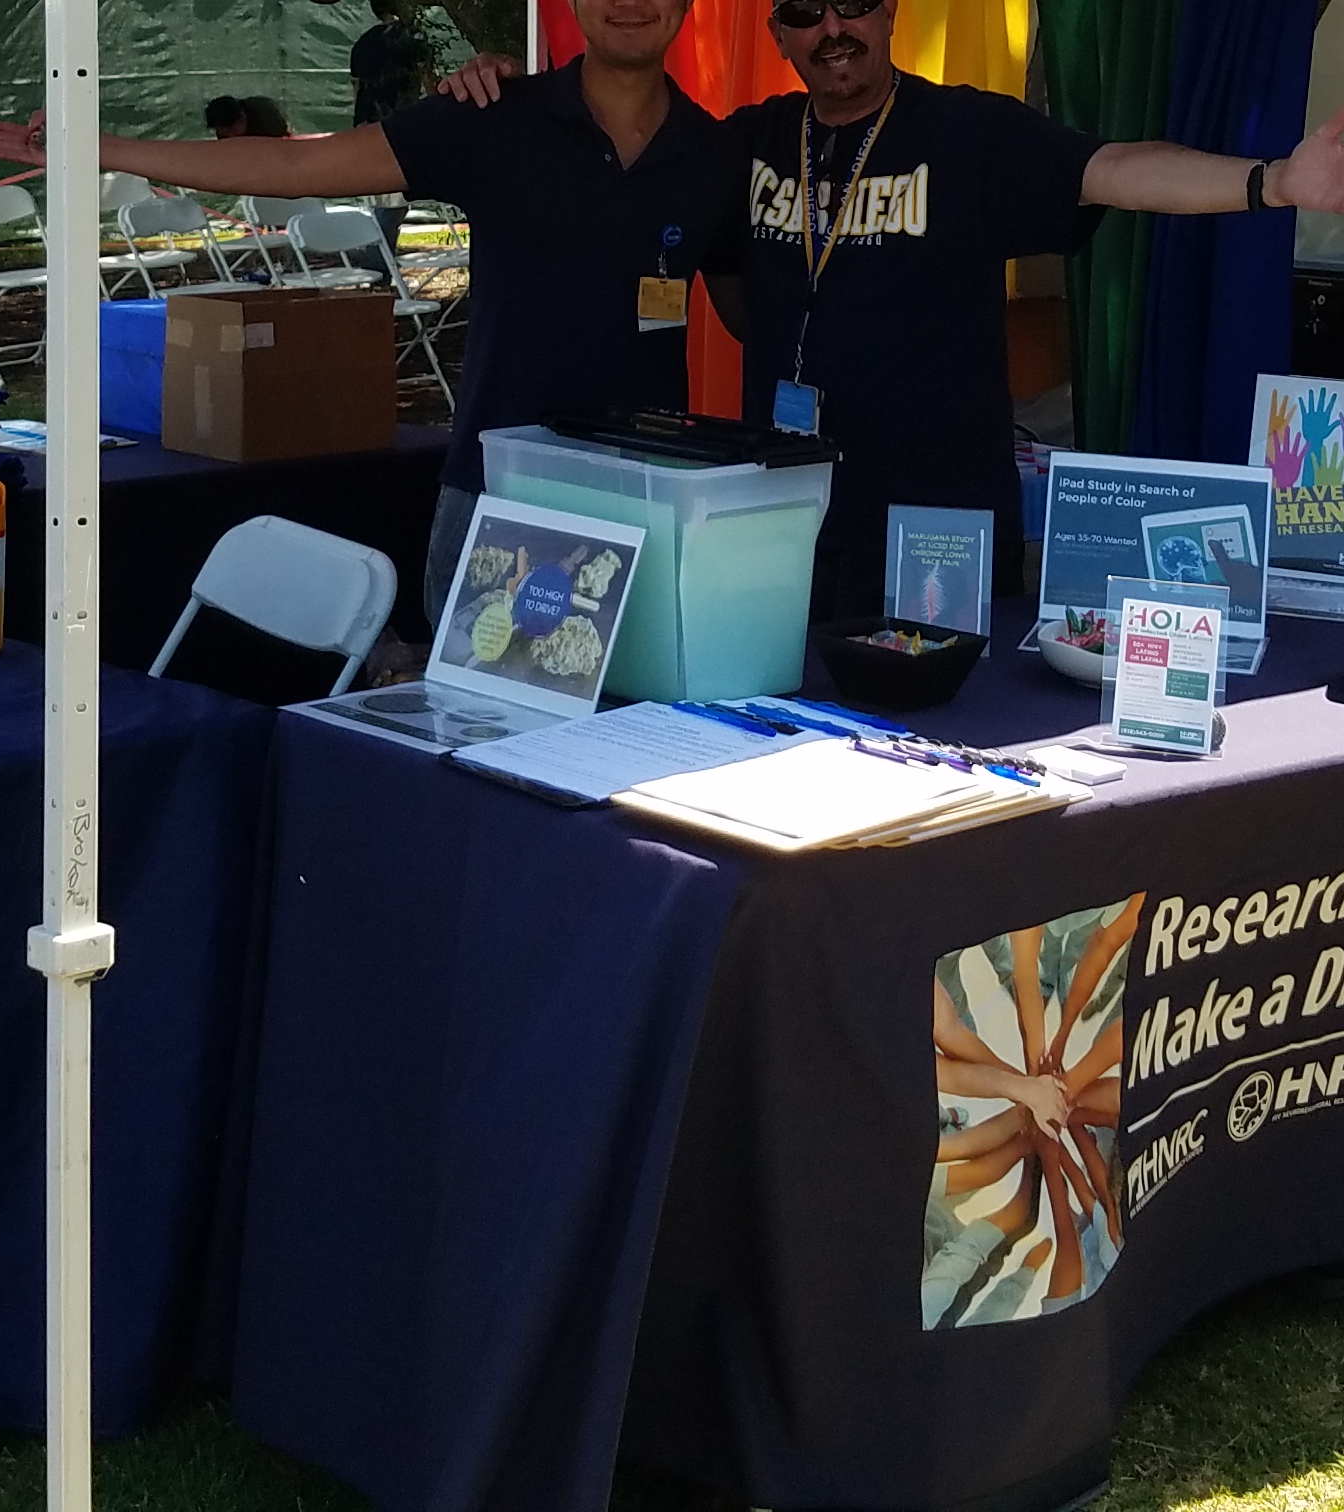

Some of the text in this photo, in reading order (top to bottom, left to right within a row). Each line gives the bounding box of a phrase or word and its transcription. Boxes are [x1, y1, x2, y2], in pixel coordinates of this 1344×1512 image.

[1059, 477, 1196, 498] iPad Study in Search of
[1275, 484, 1344, 503] HAVE
[1058, 492, 1147, 508] People of Color
[1054, 532, 1138, 547] Ages 35-70 Wanted
[1277, 525, 1293, 536] IN
[529, 585, 564, 602] TOO HIGH
[525, 598, 561, 616] TO DRIVE?
[1128, 605, 1213, 636] HOLA
[1127, 978, 1248, 1089] Make
[1258, 972, 1296, 1026] a
